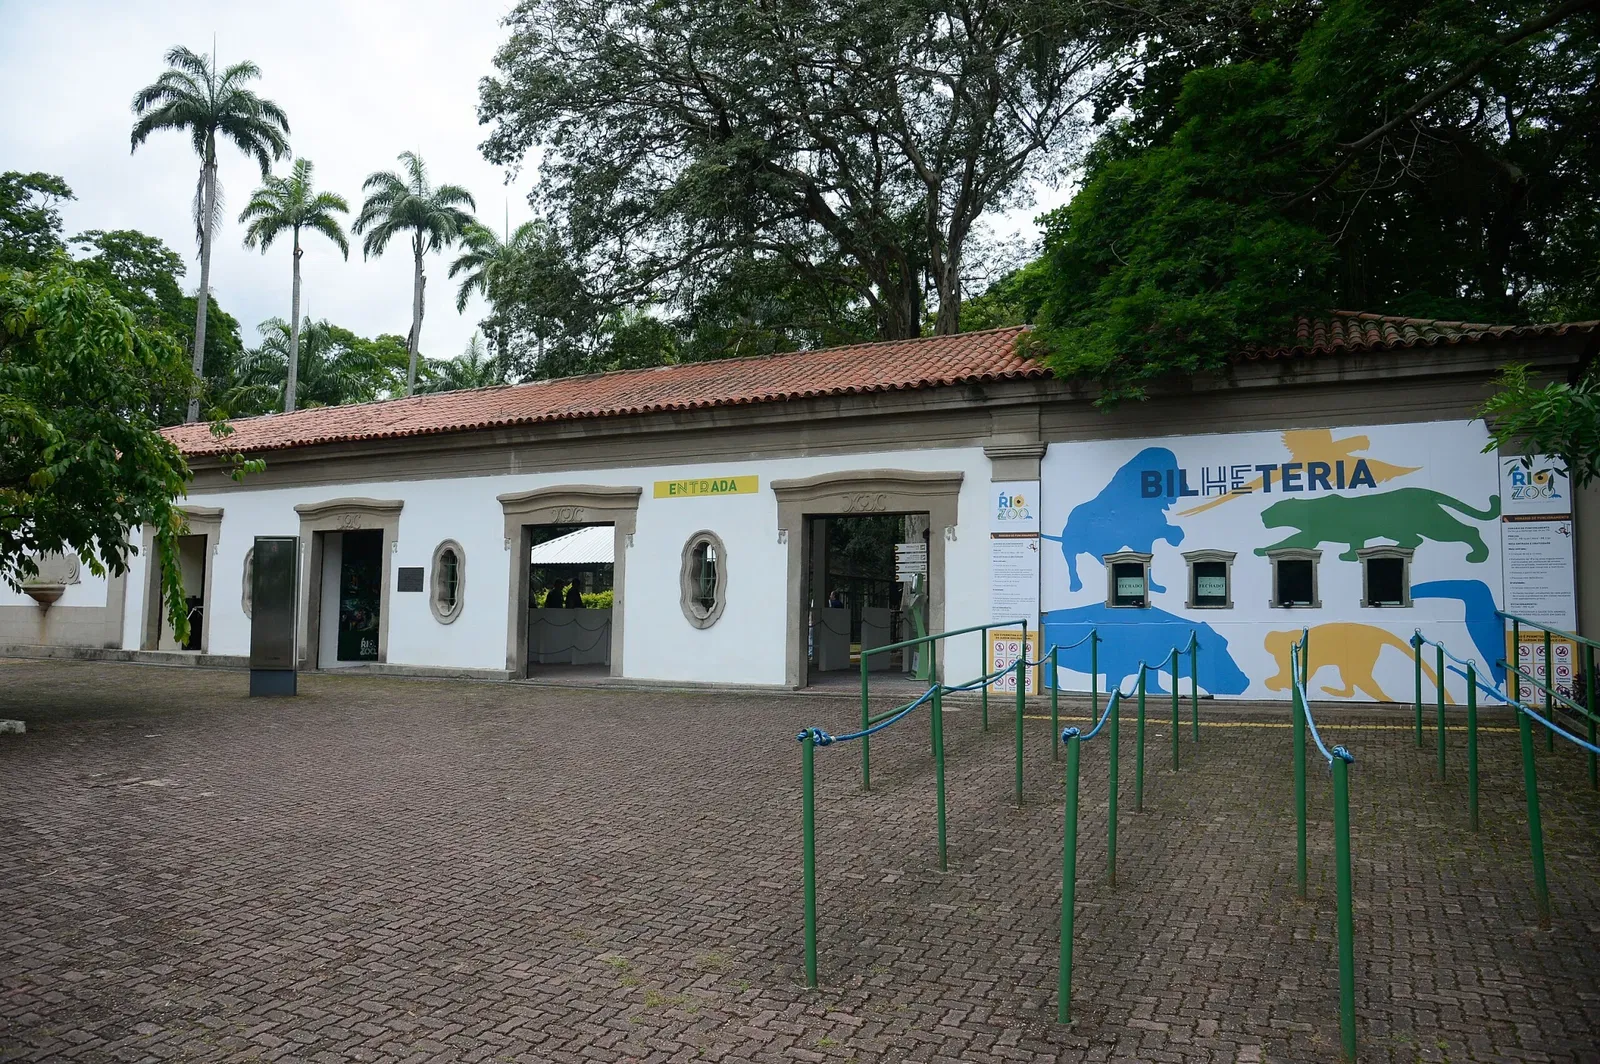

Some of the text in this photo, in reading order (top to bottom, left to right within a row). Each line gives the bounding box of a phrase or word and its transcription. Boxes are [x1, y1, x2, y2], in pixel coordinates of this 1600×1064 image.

[1141, 459, 1377, 498] BILHETERIA
[669, 480, 737, 495] ENTRADA
[1511, 486, 1558, 500] ZOO
[997, 508, 1031, 520] ZOO
